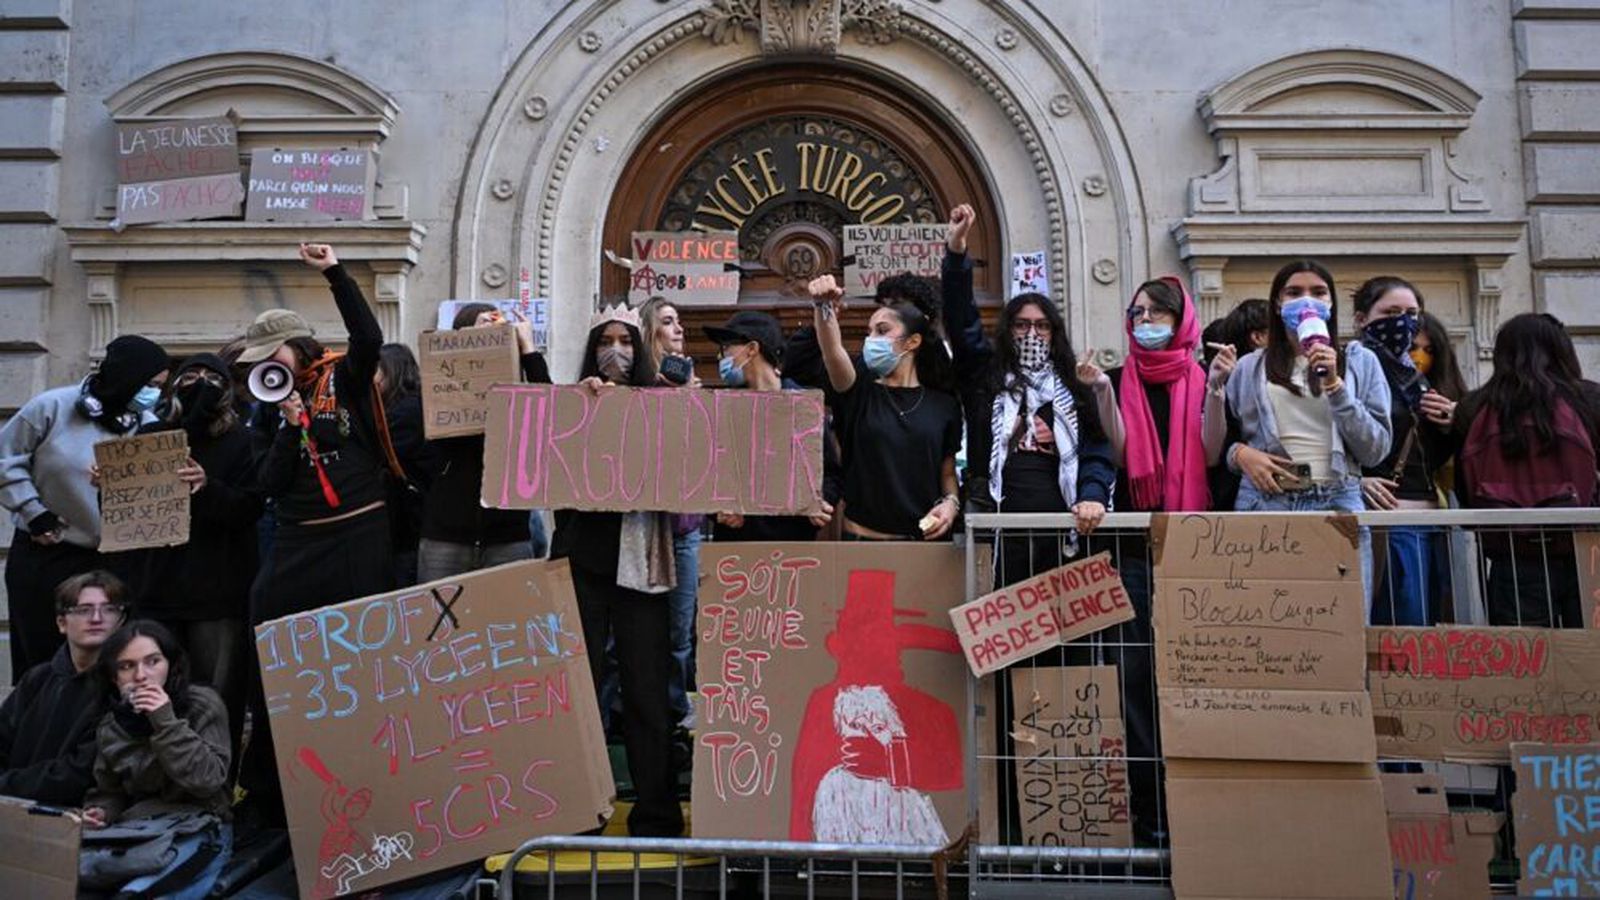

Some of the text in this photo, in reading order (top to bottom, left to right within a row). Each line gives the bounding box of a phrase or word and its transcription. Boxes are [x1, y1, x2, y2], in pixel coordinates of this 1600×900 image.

[119, 124, 237, 154] LA JEUNESSE
[302, 150, 364, 167] BLOQUE
[121, 183, 160, 213] PAS
[332, 183, 365, 194] NOUS
[797, 142, 910, 224] TURGO
[848, 228, 867, 241] ILS
[788, 248, 814, 279] 69
[858, 254, 944, 269] ILS ONT FIN
[427, 330, 512, 352] MARIANNE
[99, 438, 143, 462] TROP
[101, 461, 136, 485] POUR
[104, 485, 143, 506] ASSEZ
[114, 516, 183, 543] GAZER
[1223, 561, 1249, 590] du
[965, 595, 1016, 636] PAS
[1017, 580, 1054, 611] DE
[1178, 587, 1340, 625] Blocus Turgot
[702, 604, 808, 650] JEUNE
[971, 587, 1129, 670] PAS DE SILENCE
[722, 647, 771, 688] ET
[296, 663, 360, 720] 35
[1381, 683, 1442, 708] baise
[1452, 684, 1475, 709] ta
[1561, 689, 1600, 716] pa
[1340, 700, 1363, 718] FN
[1022, 749, 1054, 823] VOIX
[1078, 742, 1112, 838] PERDRE
[410, 760, 559, 858] 5 CRS
